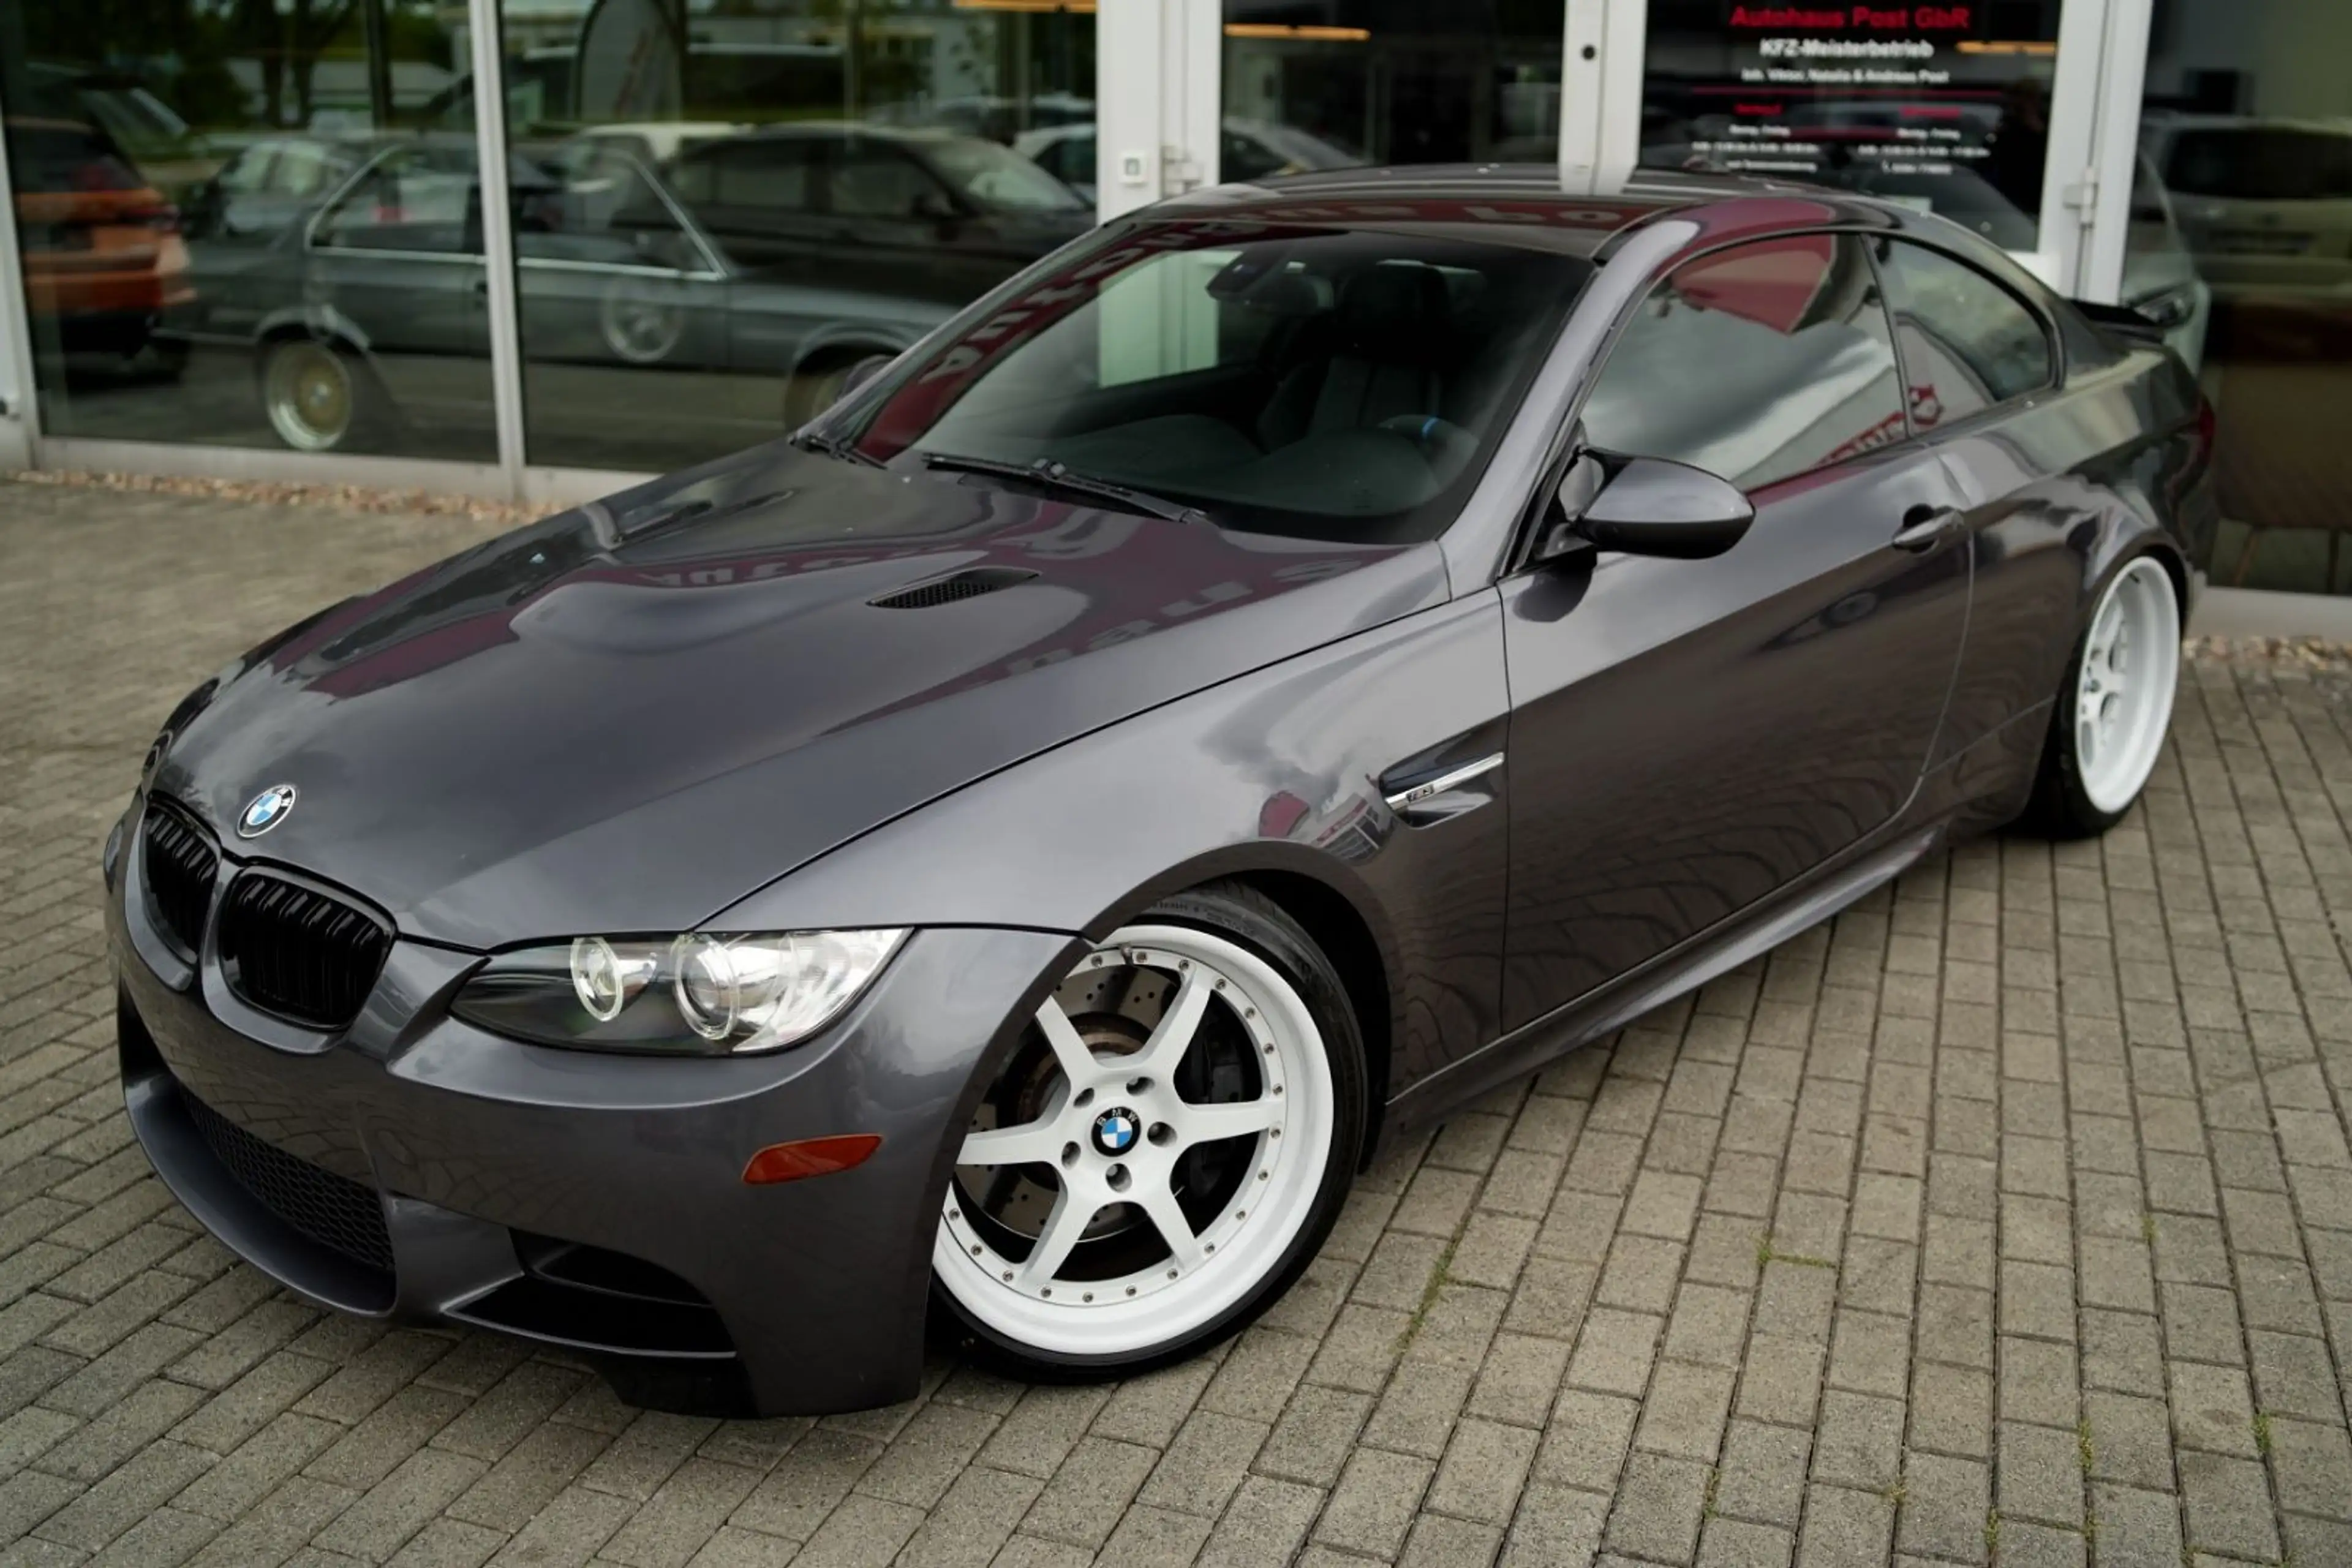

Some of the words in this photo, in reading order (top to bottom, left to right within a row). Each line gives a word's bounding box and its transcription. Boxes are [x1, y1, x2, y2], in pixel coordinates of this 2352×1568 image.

[1730, 6, 1844, 28] Autohaus
[1852, 7, 1909, 28] Post
[1915, 7, 1970, 28] GbR
[1759, 38, 1936, 58] KFZ-Meisterbetrieb
[1096, 1107, 1139, 1126] BMW
